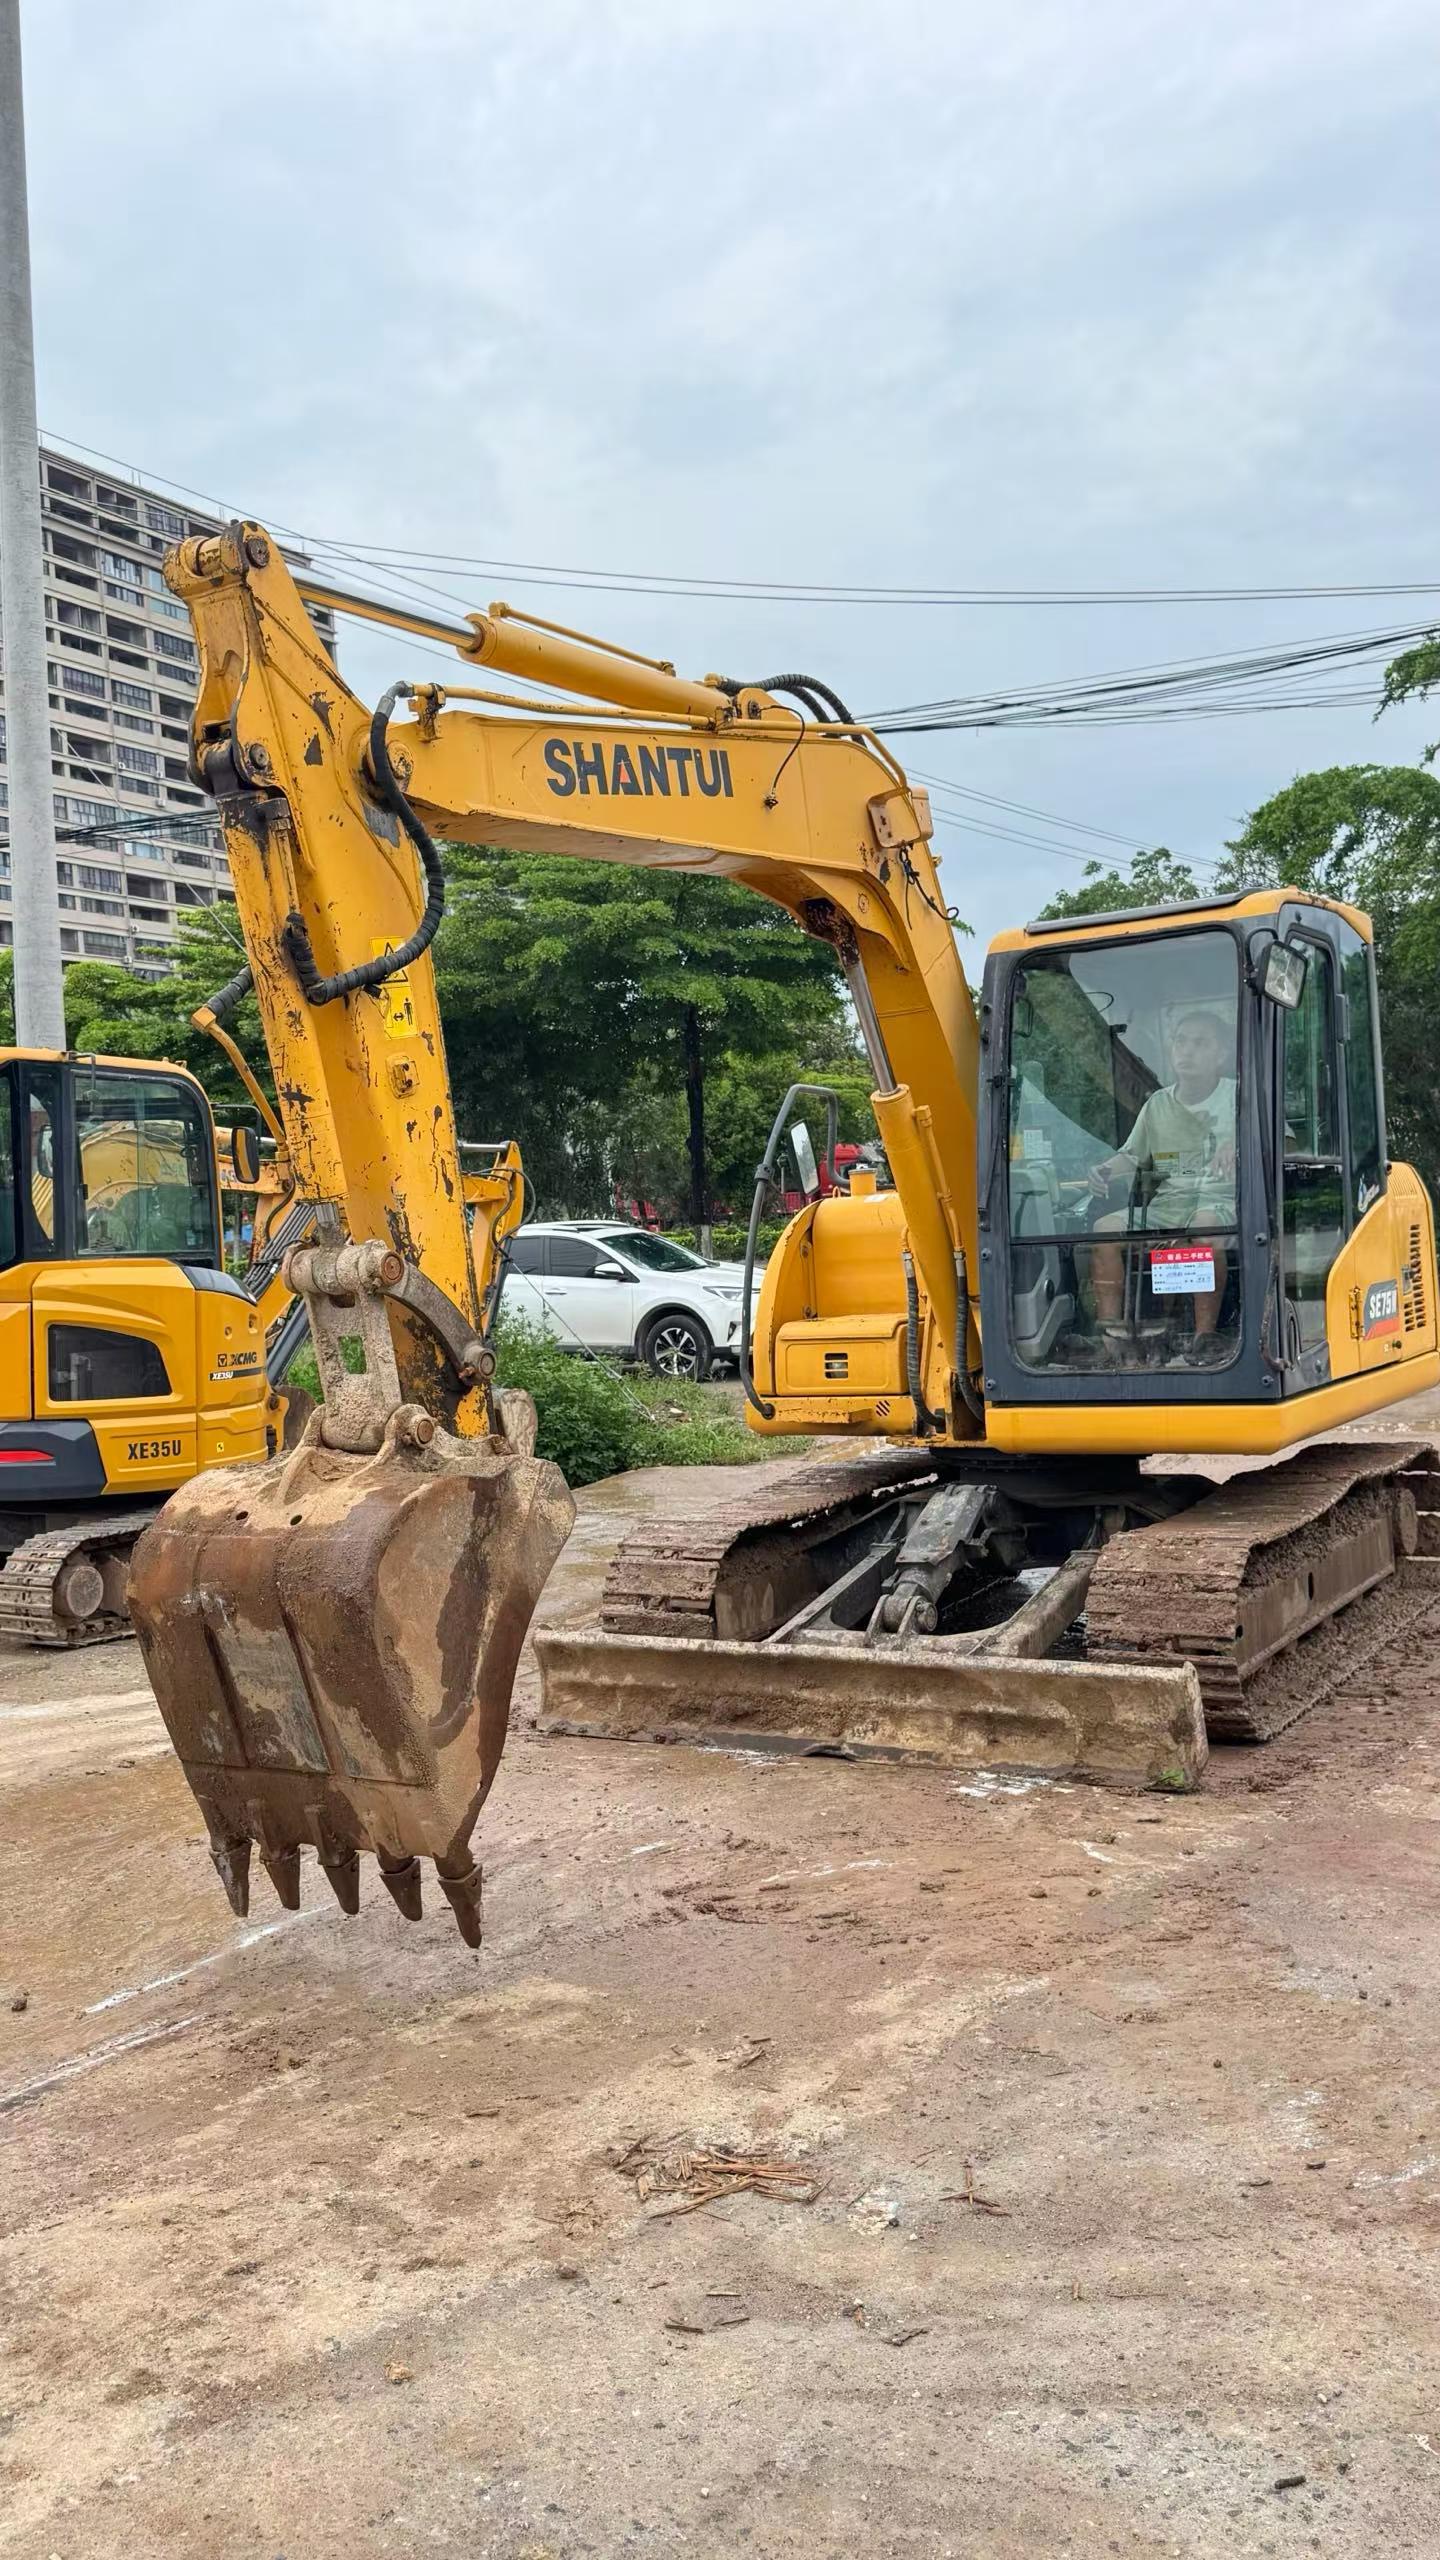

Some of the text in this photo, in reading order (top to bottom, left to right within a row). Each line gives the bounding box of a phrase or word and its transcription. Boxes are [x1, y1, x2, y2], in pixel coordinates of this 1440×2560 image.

[544, 738, 734, 797] SHANTUI
[228, 1352, 257, 1366] XCMG
[128, 1439, 182, 1460] XE35U
